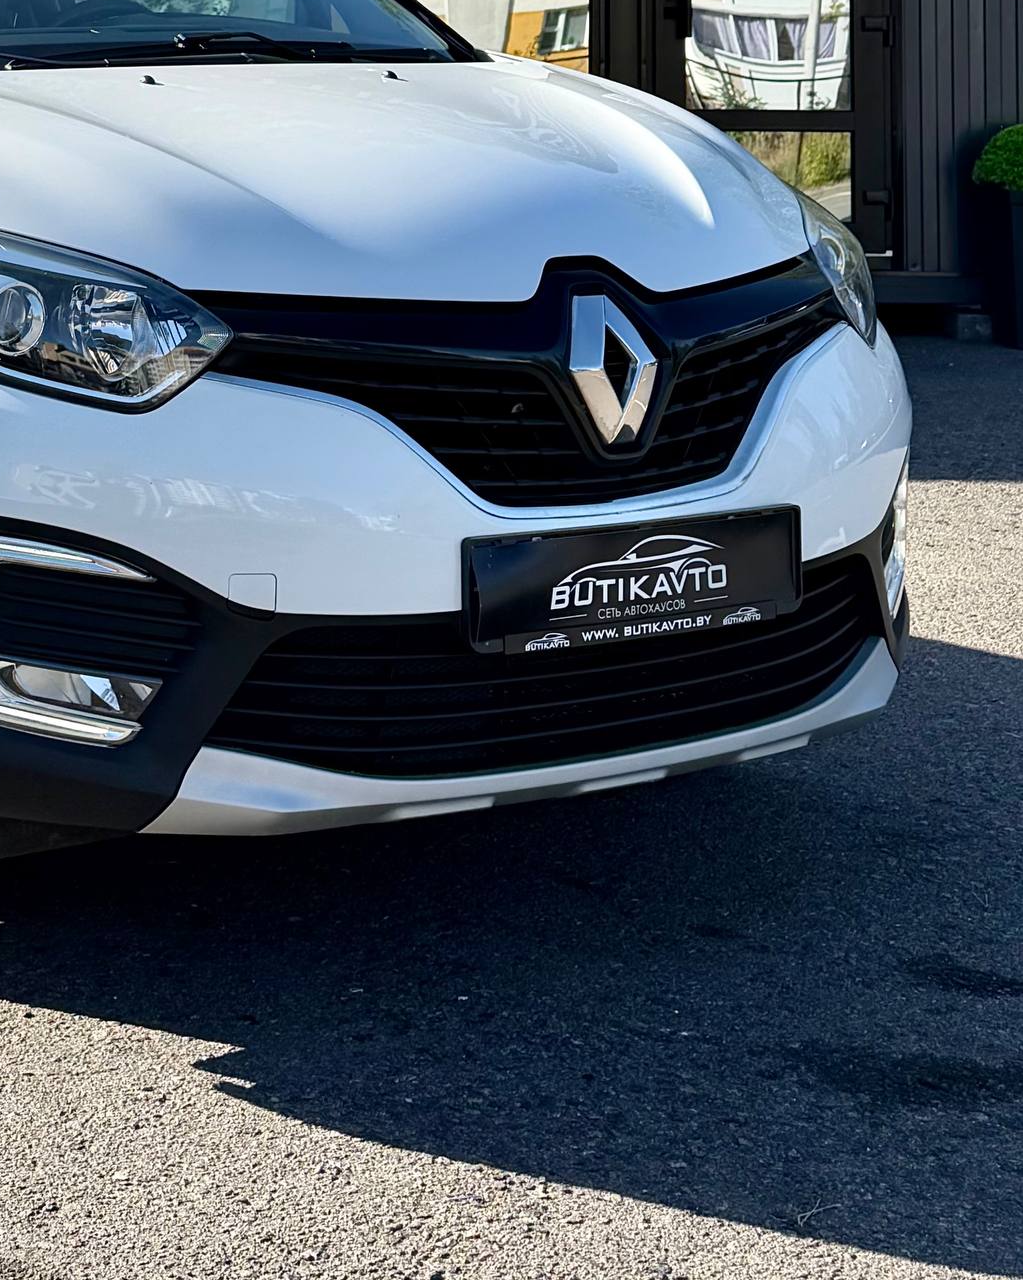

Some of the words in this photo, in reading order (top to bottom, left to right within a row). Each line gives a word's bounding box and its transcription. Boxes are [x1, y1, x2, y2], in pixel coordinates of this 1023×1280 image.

[550, 564, 727, 610] BUTIKAVTO
[597, 607, 622, 620] СЕТЬ
[624, 599, 686, 617] АВТОХАУСОВ
[722, 613, 761, 626] BUTIKAVTO
[624, 615, 712, 636] BUTIKAVTO.BY
[524, 639, 570, 652] BUTIKAVTO
